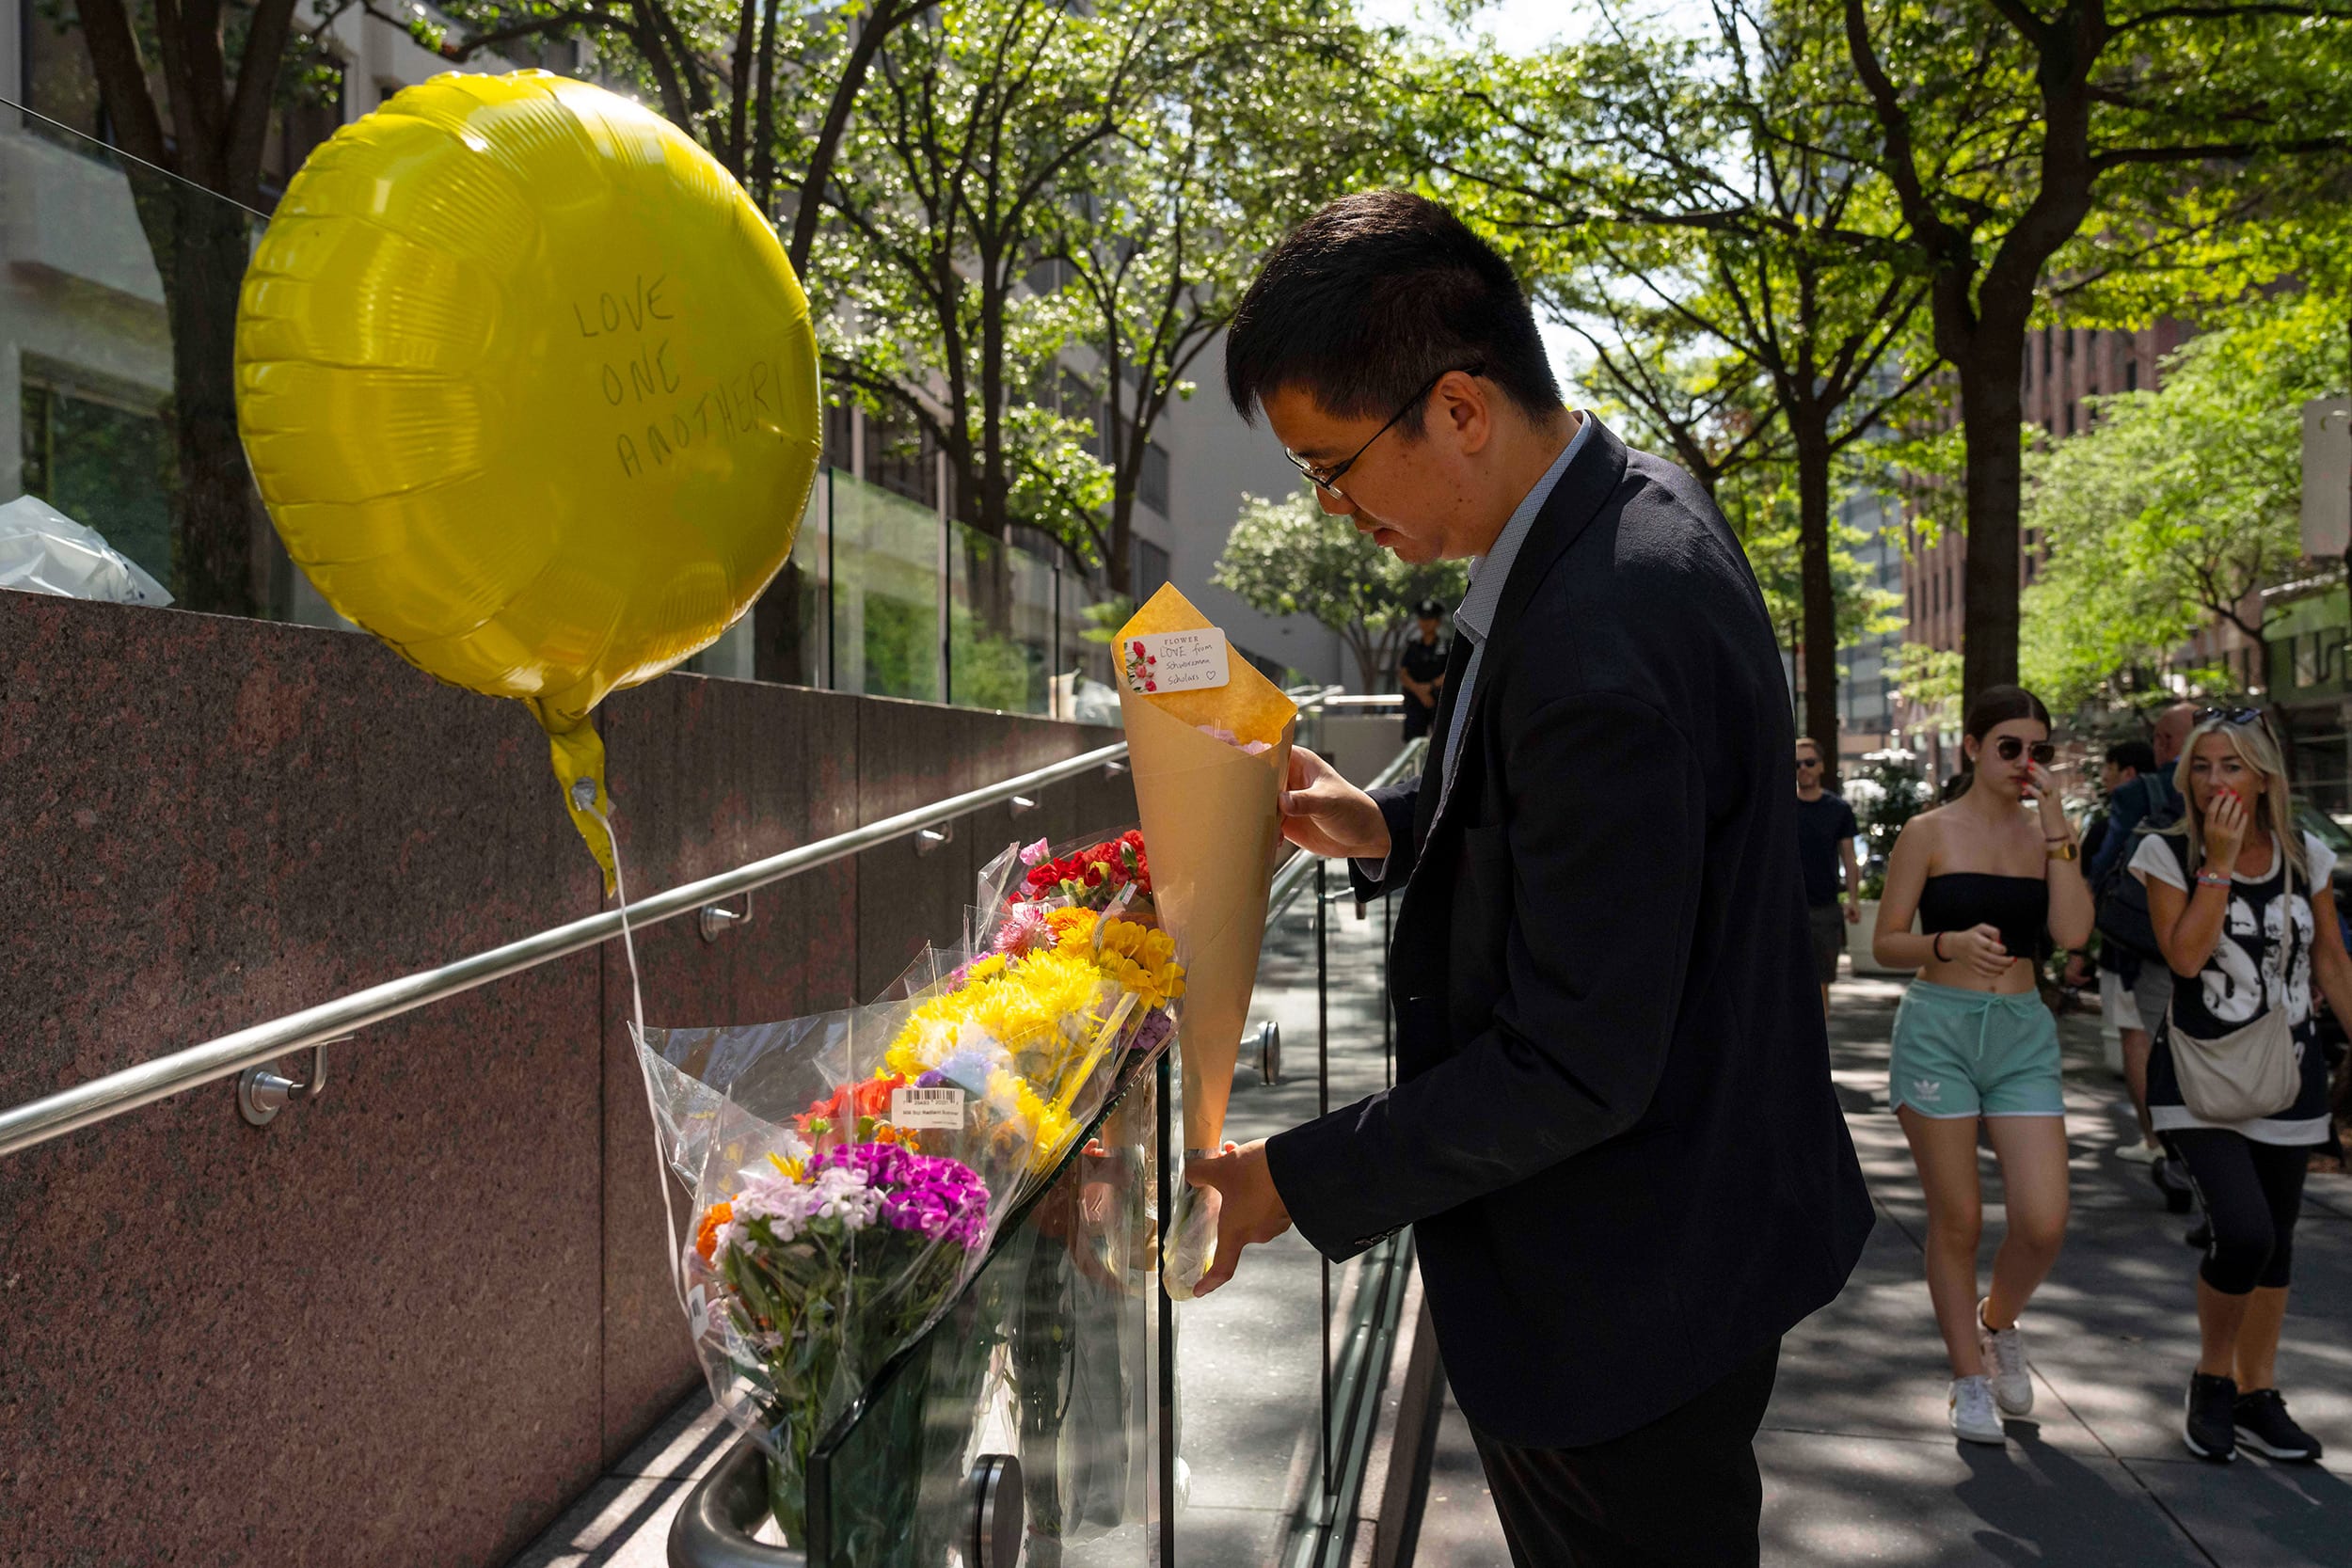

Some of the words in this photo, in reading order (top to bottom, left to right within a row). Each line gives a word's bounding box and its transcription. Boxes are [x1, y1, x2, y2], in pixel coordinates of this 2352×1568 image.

[572, 274, 675, 339] LOVE
[602, 339, 680, 406] ONE
[1159, 645, 1187, 658] LOVE
[1191, 642, 1213, 656] from
[1164, 635, 1200, 645] FLOWER
